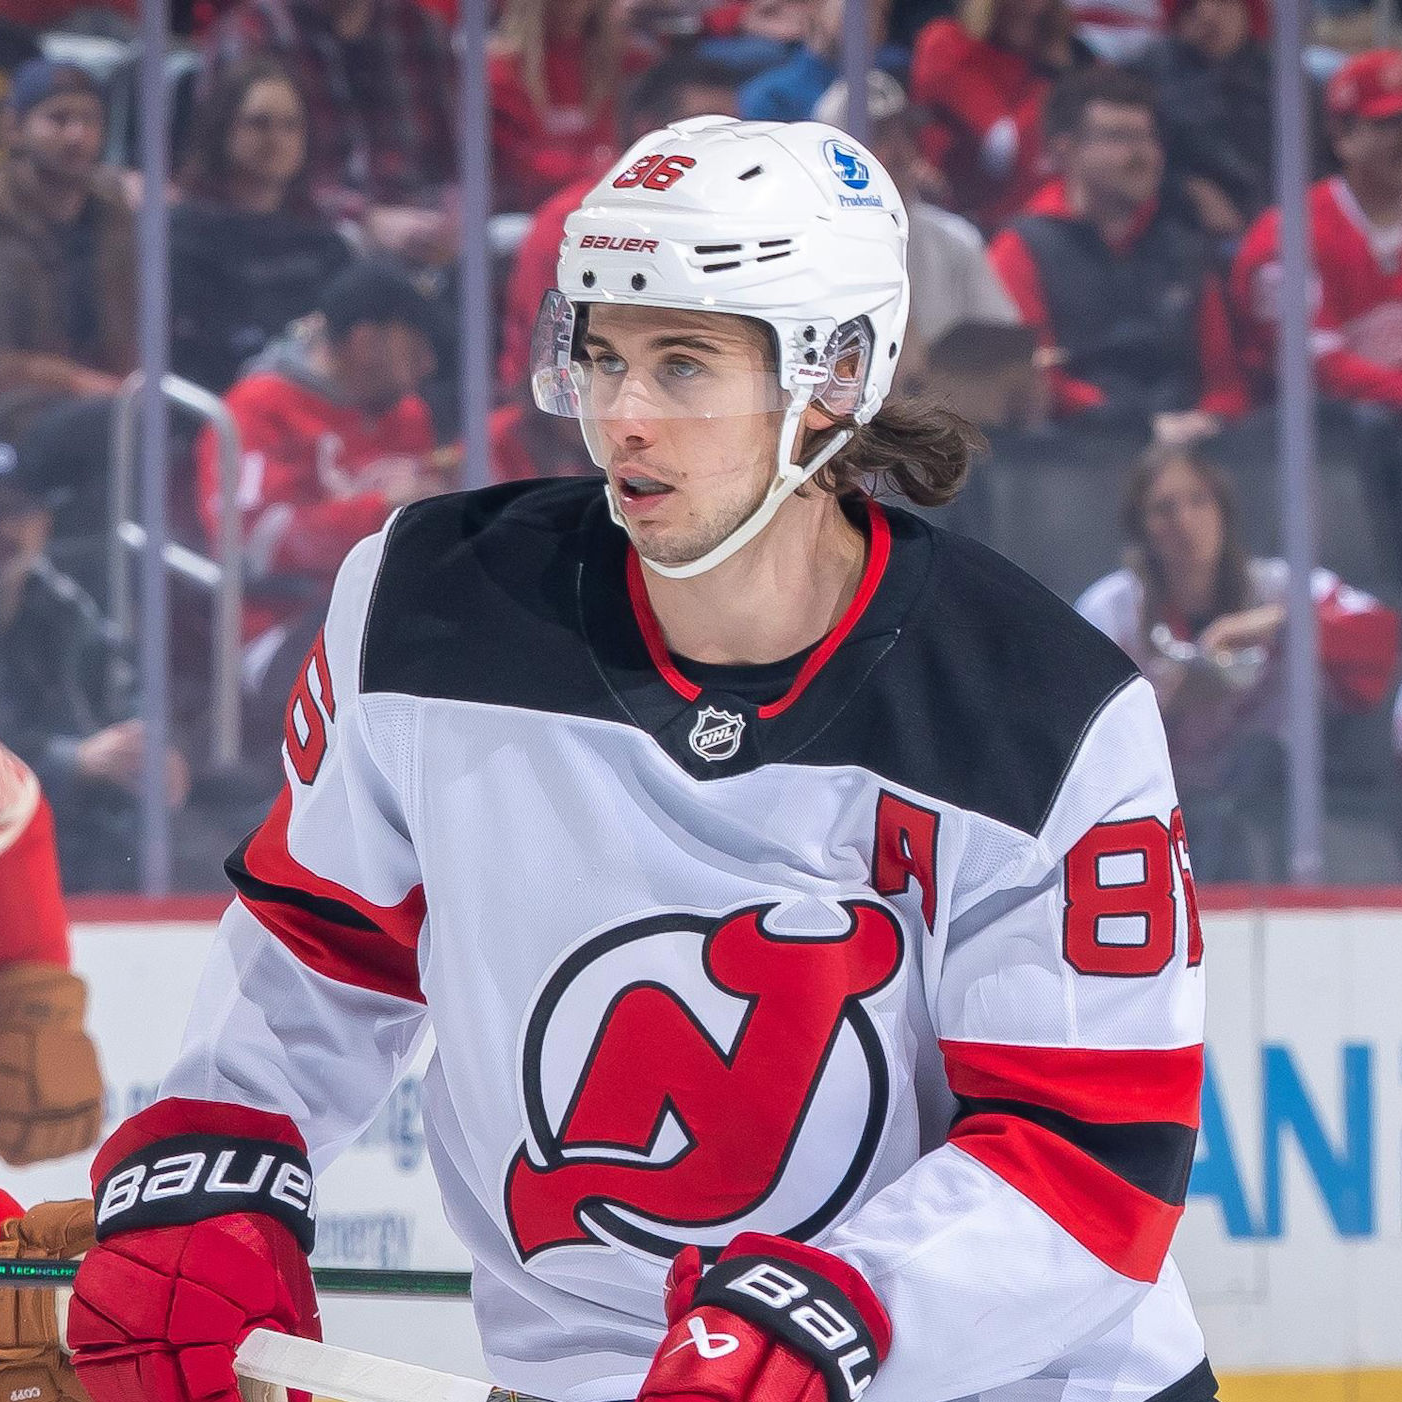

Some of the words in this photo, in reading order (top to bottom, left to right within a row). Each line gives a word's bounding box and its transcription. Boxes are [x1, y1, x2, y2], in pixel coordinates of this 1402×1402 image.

[838, 193, 883, 208] Prudential
[699, 726, 734, 747] NHL
[873, 788, 940, 936] A
